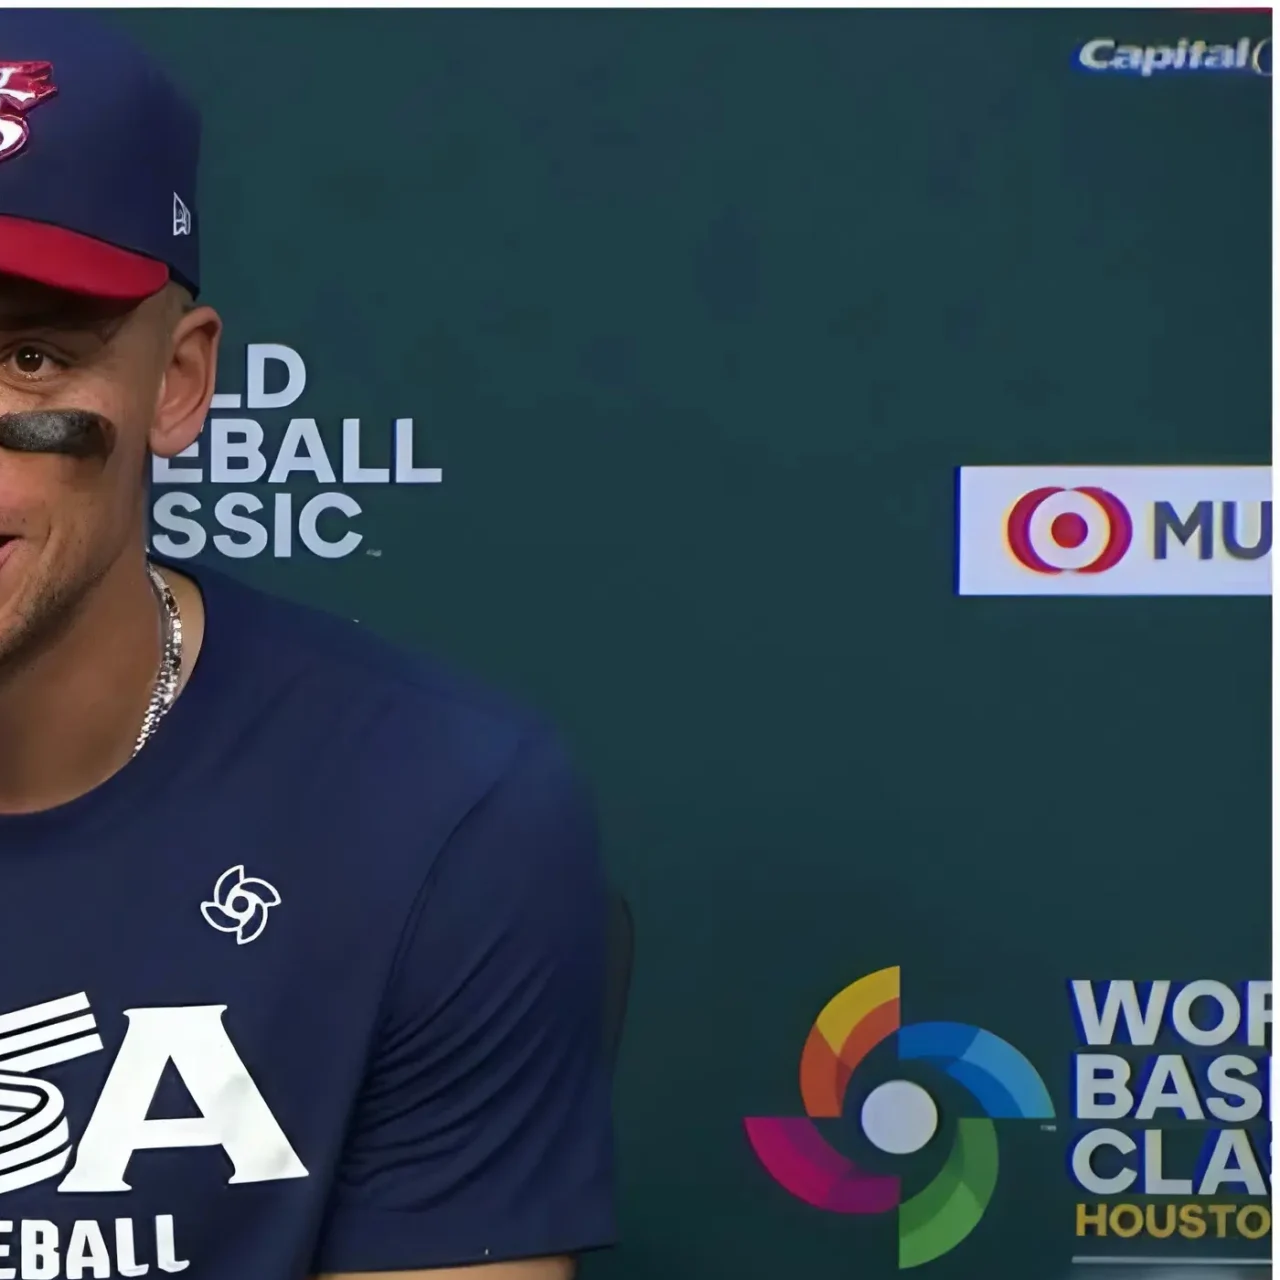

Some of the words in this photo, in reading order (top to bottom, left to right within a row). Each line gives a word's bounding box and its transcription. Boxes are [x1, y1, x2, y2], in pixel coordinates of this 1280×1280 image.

[1154, 501, 1272, 560] MU
[1076, 1054, 1272, 1122] BAS
[1072, 1128, 1272, 1195] CLA
